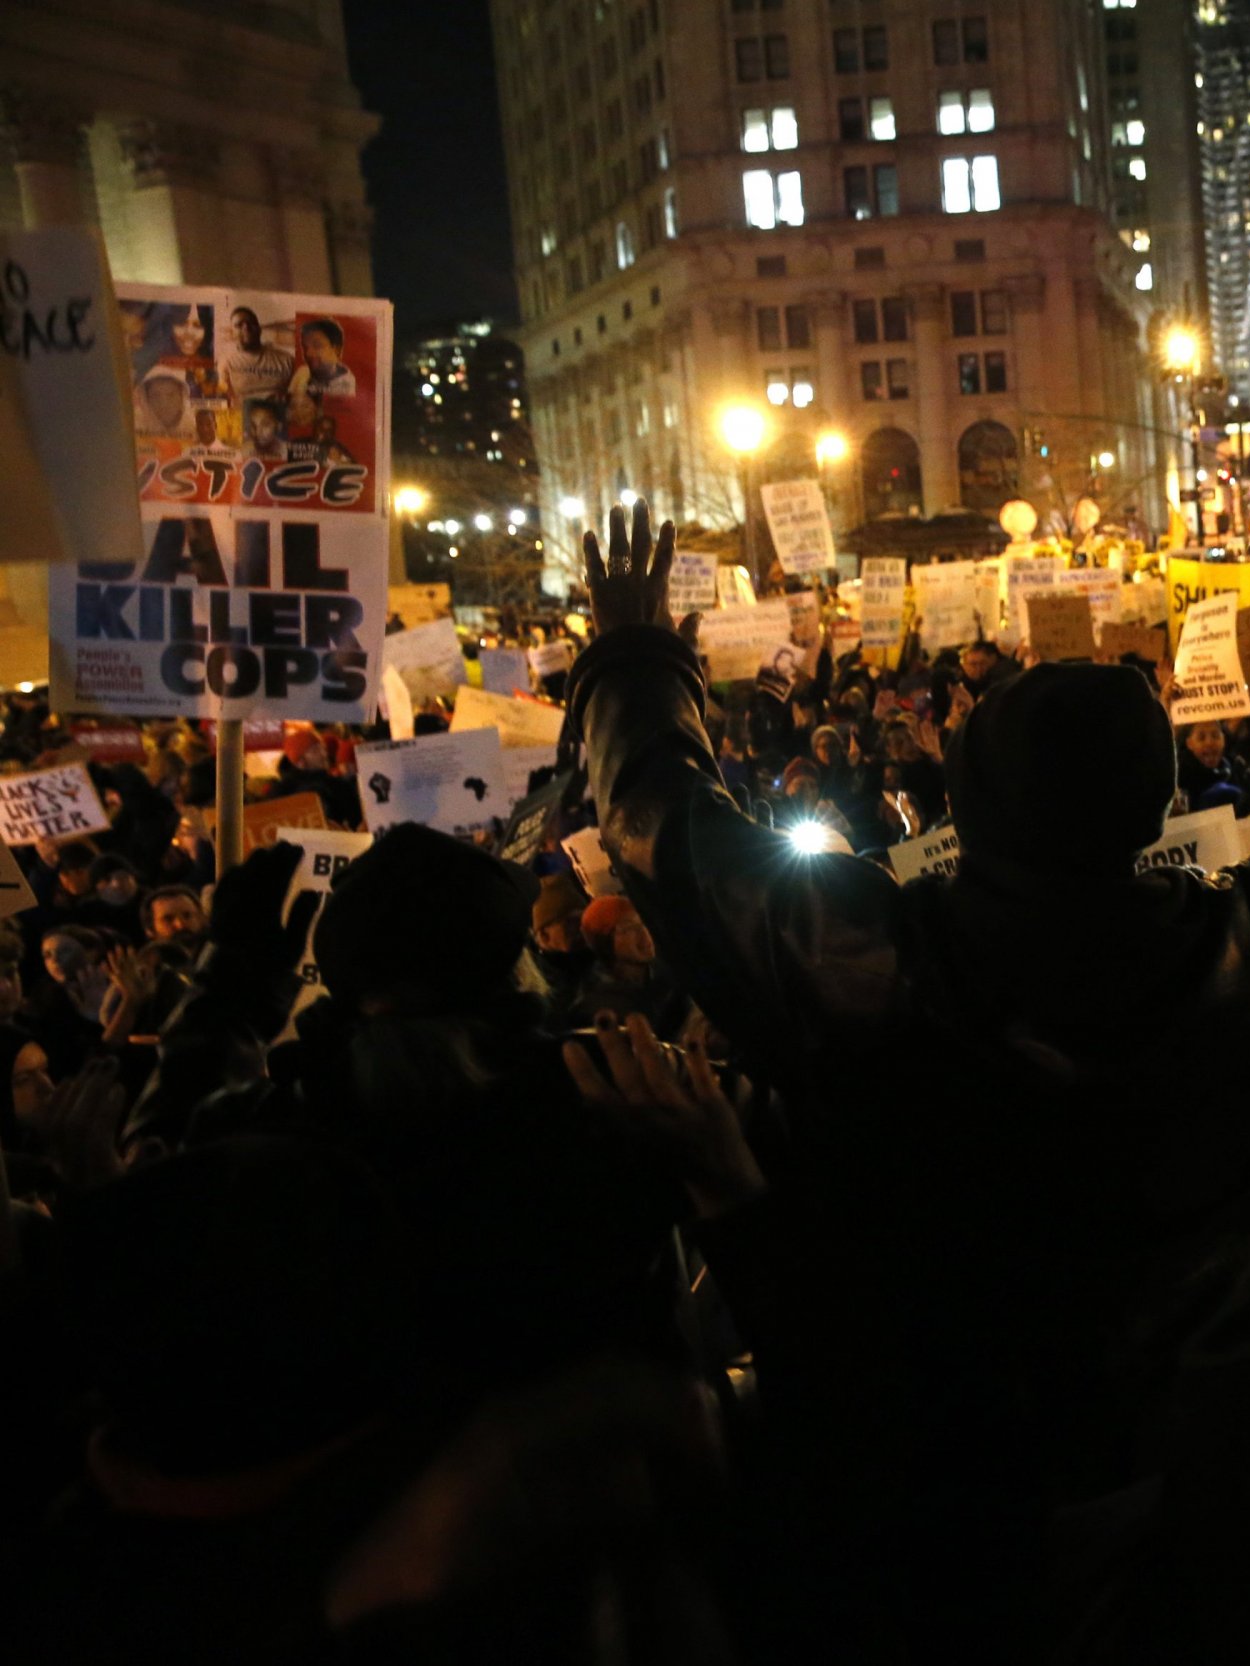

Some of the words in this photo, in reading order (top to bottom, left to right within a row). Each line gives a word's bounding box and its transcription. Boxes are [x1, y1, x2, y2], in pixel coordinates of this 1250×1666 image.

[138, 456, 368, 506] STICE
[77, 517, 350, 592] AIL
[76, 583, 364, 651] KILLER
[160, 644, 368, 702] COPS
[1207, 681, 1240, 697] STOP!
[1177, 700, 1245, 716] revcom.us
